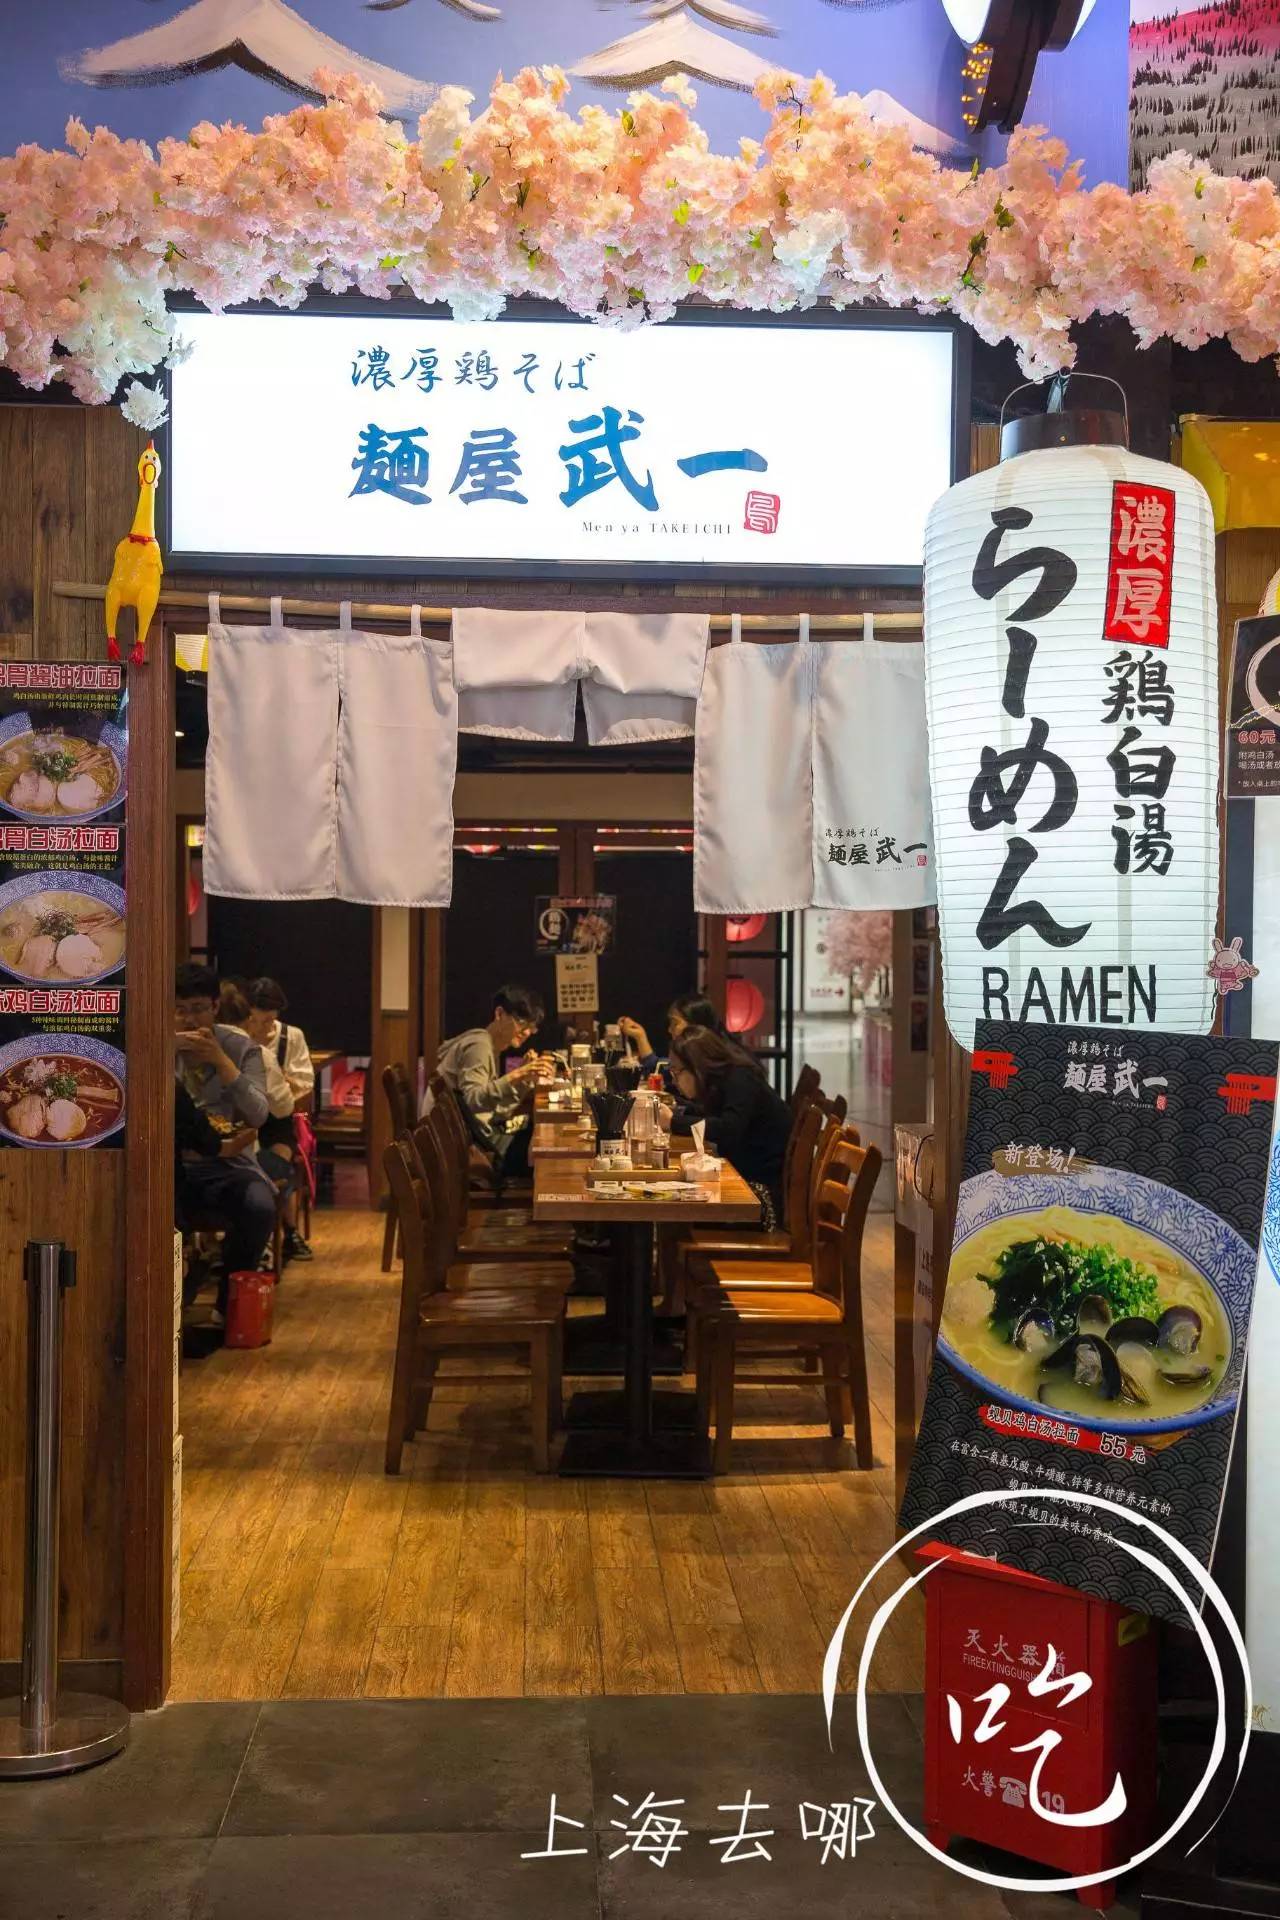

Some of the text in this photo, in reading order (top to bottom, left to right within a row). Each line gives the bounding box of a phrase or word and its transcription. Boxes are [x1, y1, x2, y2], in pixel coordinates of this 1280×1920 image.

[351, 345, 596, 394] 濃厚鶏そば
[347, 404, 769, 512] 麺屋武一
[582, 521, 732, 535] Men ya TAKEICHI
[967, 506, 1093, 952] らーめん
[1238, 729, 1276, 744] 60元
[0, 826, 119, 852] 骨白汤拉面
[828, 836, 928, 866] 麺屋武一
[0, 989, 120, 1014] 鸡白汤拉面
[981, 963, 1158, 1023] RAMEN
[1063, 1059, 1169, 1099] 麺屋武一
[1003, 1141, 1076, 1174] 新登场!
[987, 1404, 1080, 1445] 蚬贝鸡白汤拉面
[961, 1765, 997, 1797] 火警
